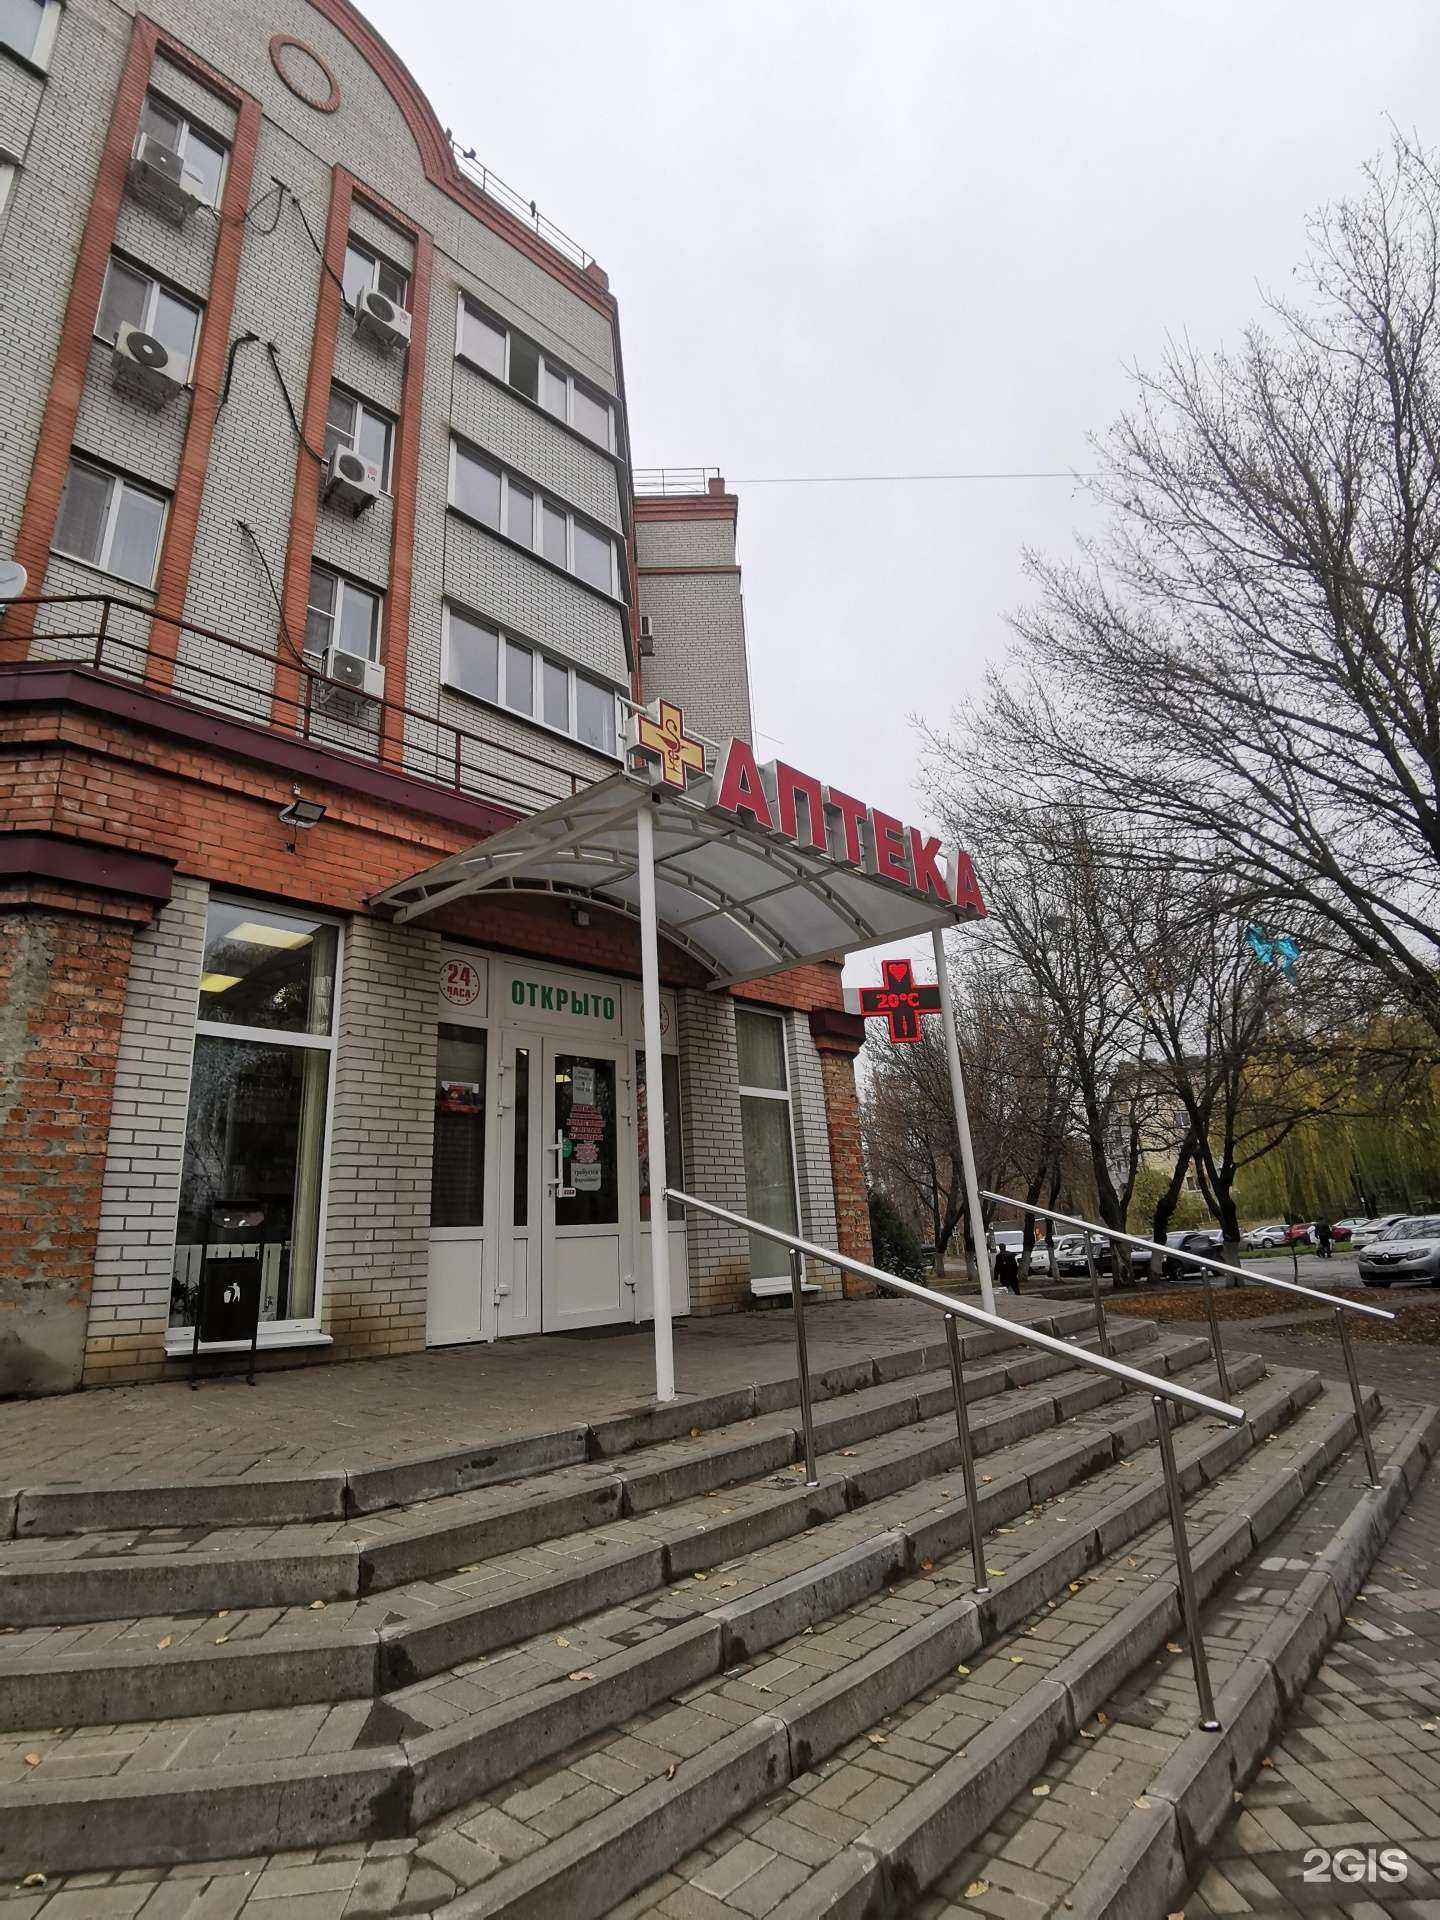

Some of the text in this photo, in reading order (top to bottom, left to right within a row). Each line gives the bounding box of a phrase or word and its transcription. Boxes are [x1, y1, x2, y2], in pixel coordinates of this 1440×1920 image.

[716, 737, 988, 918] АПТЕКА
[448, 964, 471, 987] 24
[447, 986, 471, 998] ЧАСА
[511, 980, 615, 1020] ОТКРЫТО
